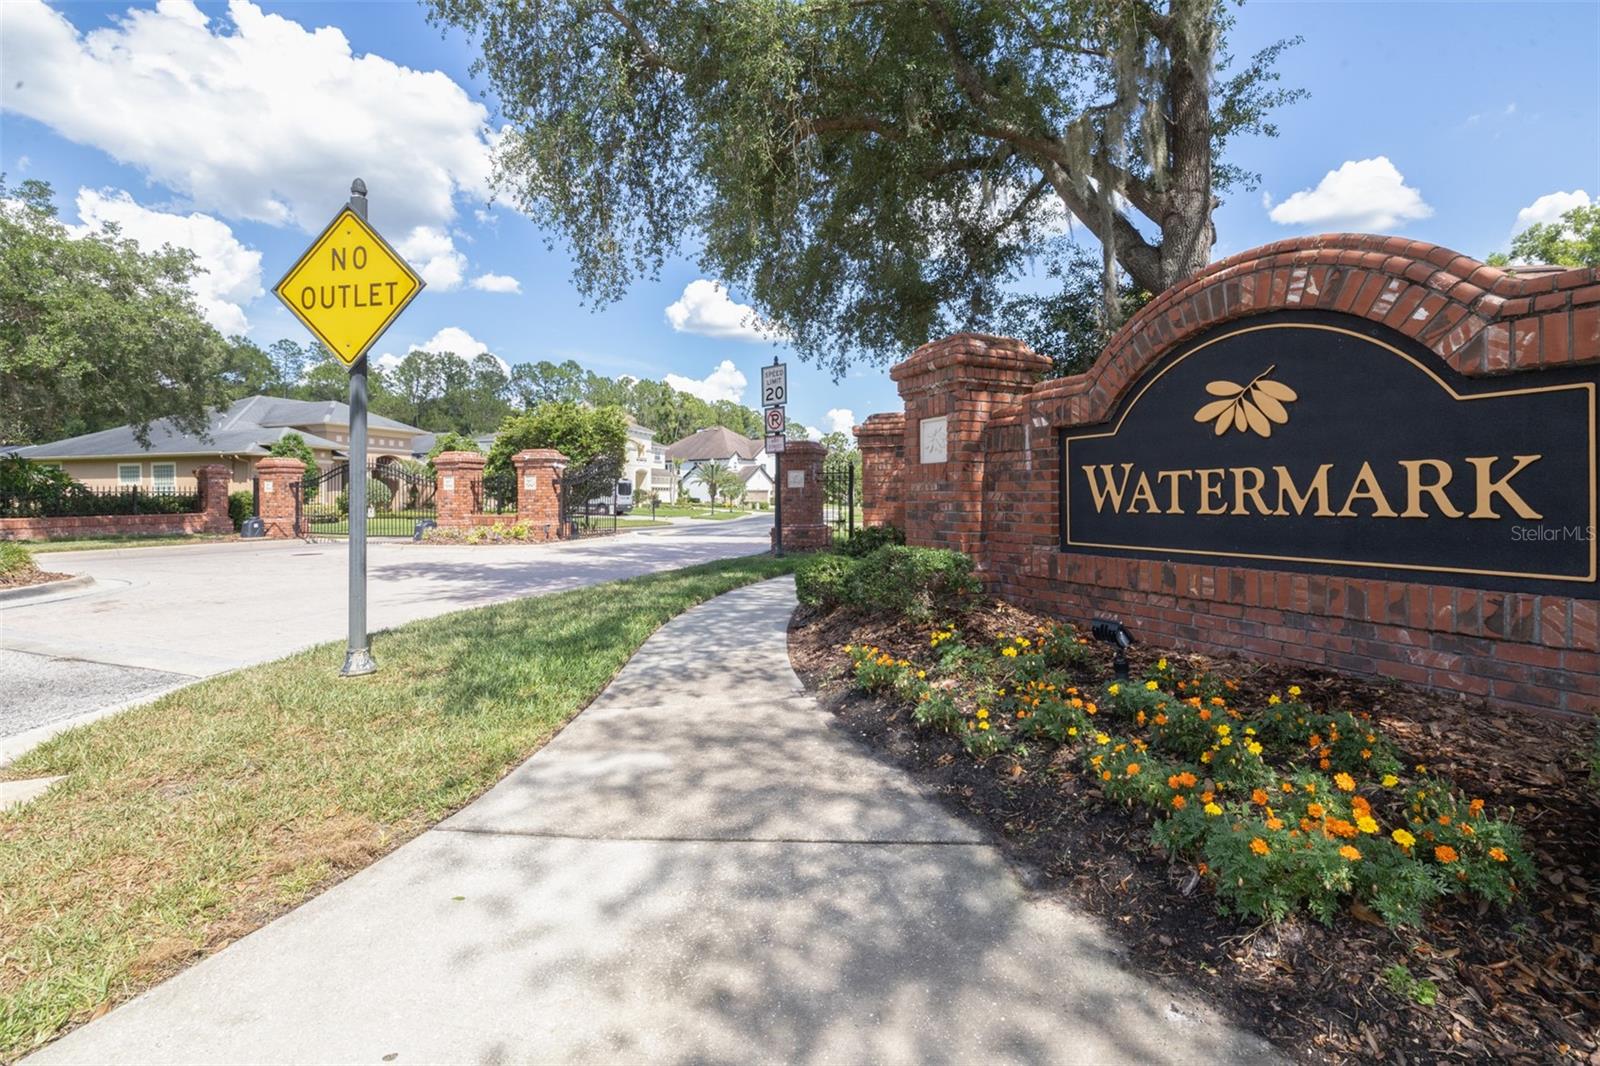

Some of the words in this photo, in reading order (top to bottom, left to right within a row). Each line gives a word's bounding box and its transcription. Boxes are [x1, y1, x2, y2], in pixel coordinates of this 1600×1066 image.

[331, 246, 368, 271] NO
[301, 282, 398, 310] OUTLET
[765, 369, 784, 378] SPEED
[766, 378, 782, 386] LIMIT
[766, 386, 784, 401] 20
[1081, 454, 1543, 520] WATERMARK
